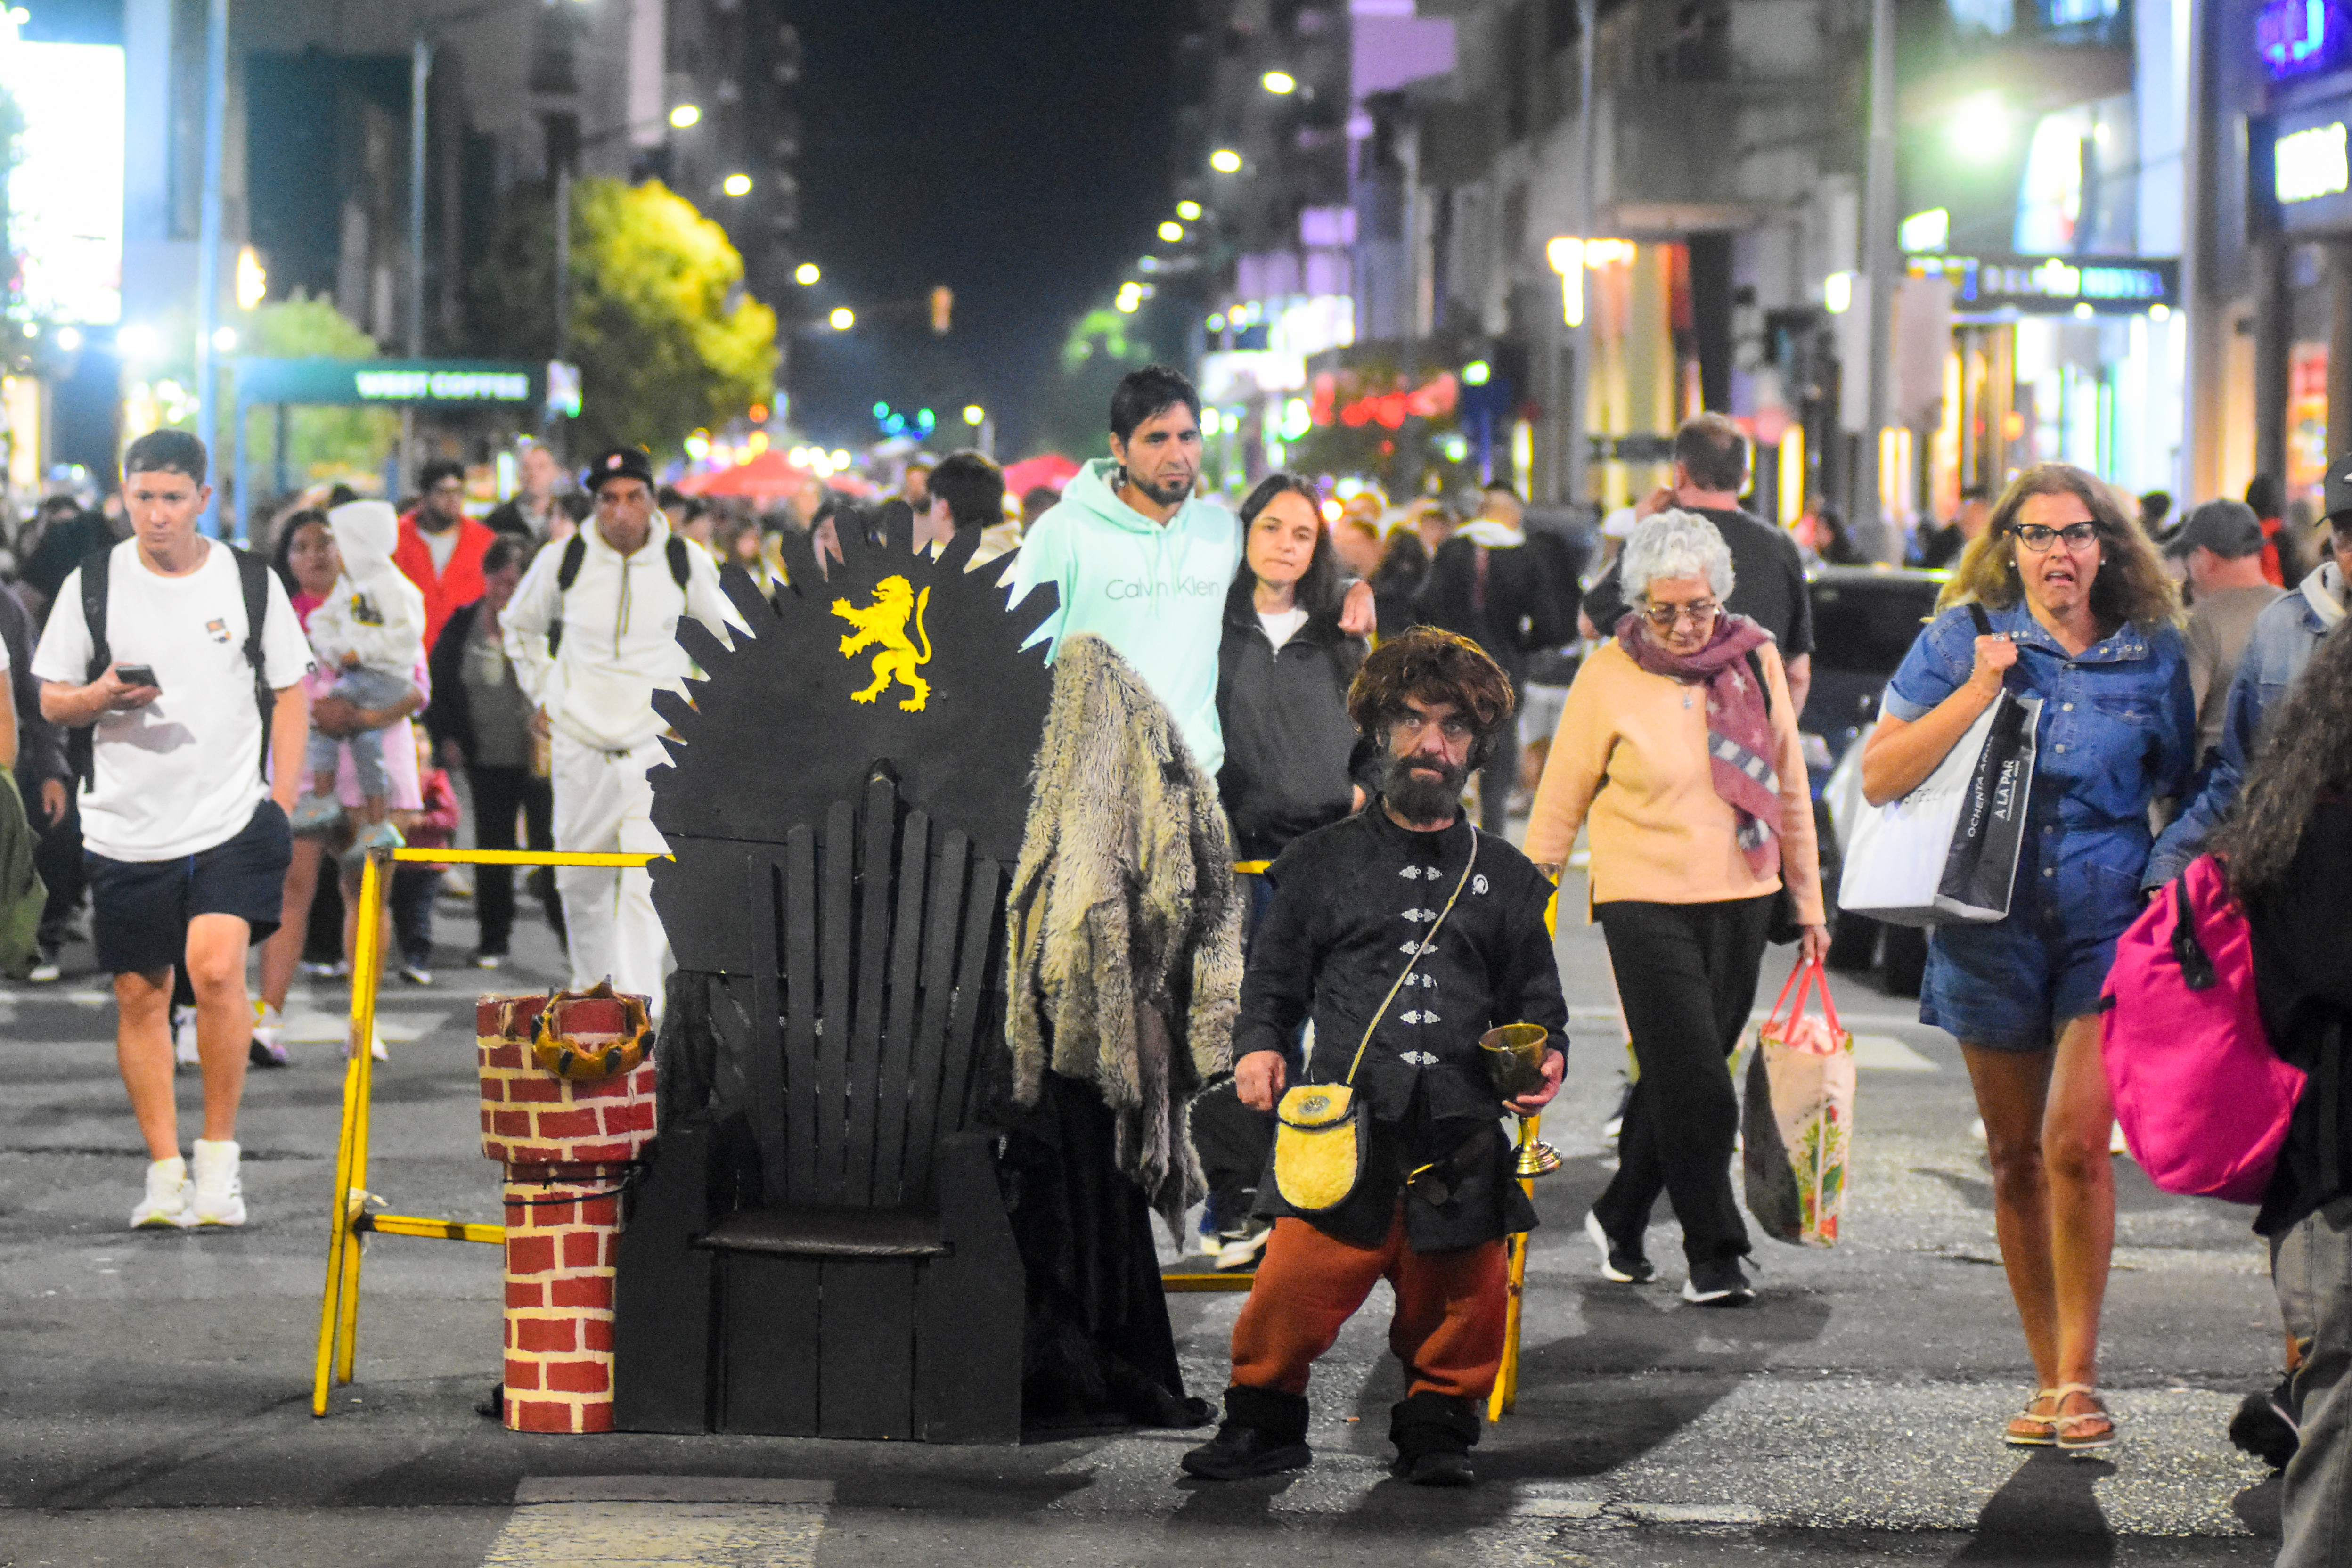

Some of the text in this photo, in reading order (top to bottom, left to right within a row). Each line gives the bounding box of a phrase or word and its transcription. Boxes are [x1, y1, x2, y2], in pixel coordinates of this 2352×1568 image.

[1106, 575, 1219, 600] Calvn Klein
[1968, 777, 1984, 838] OCHENTA
[1994, 760, 2015, 819] A LA PAR
